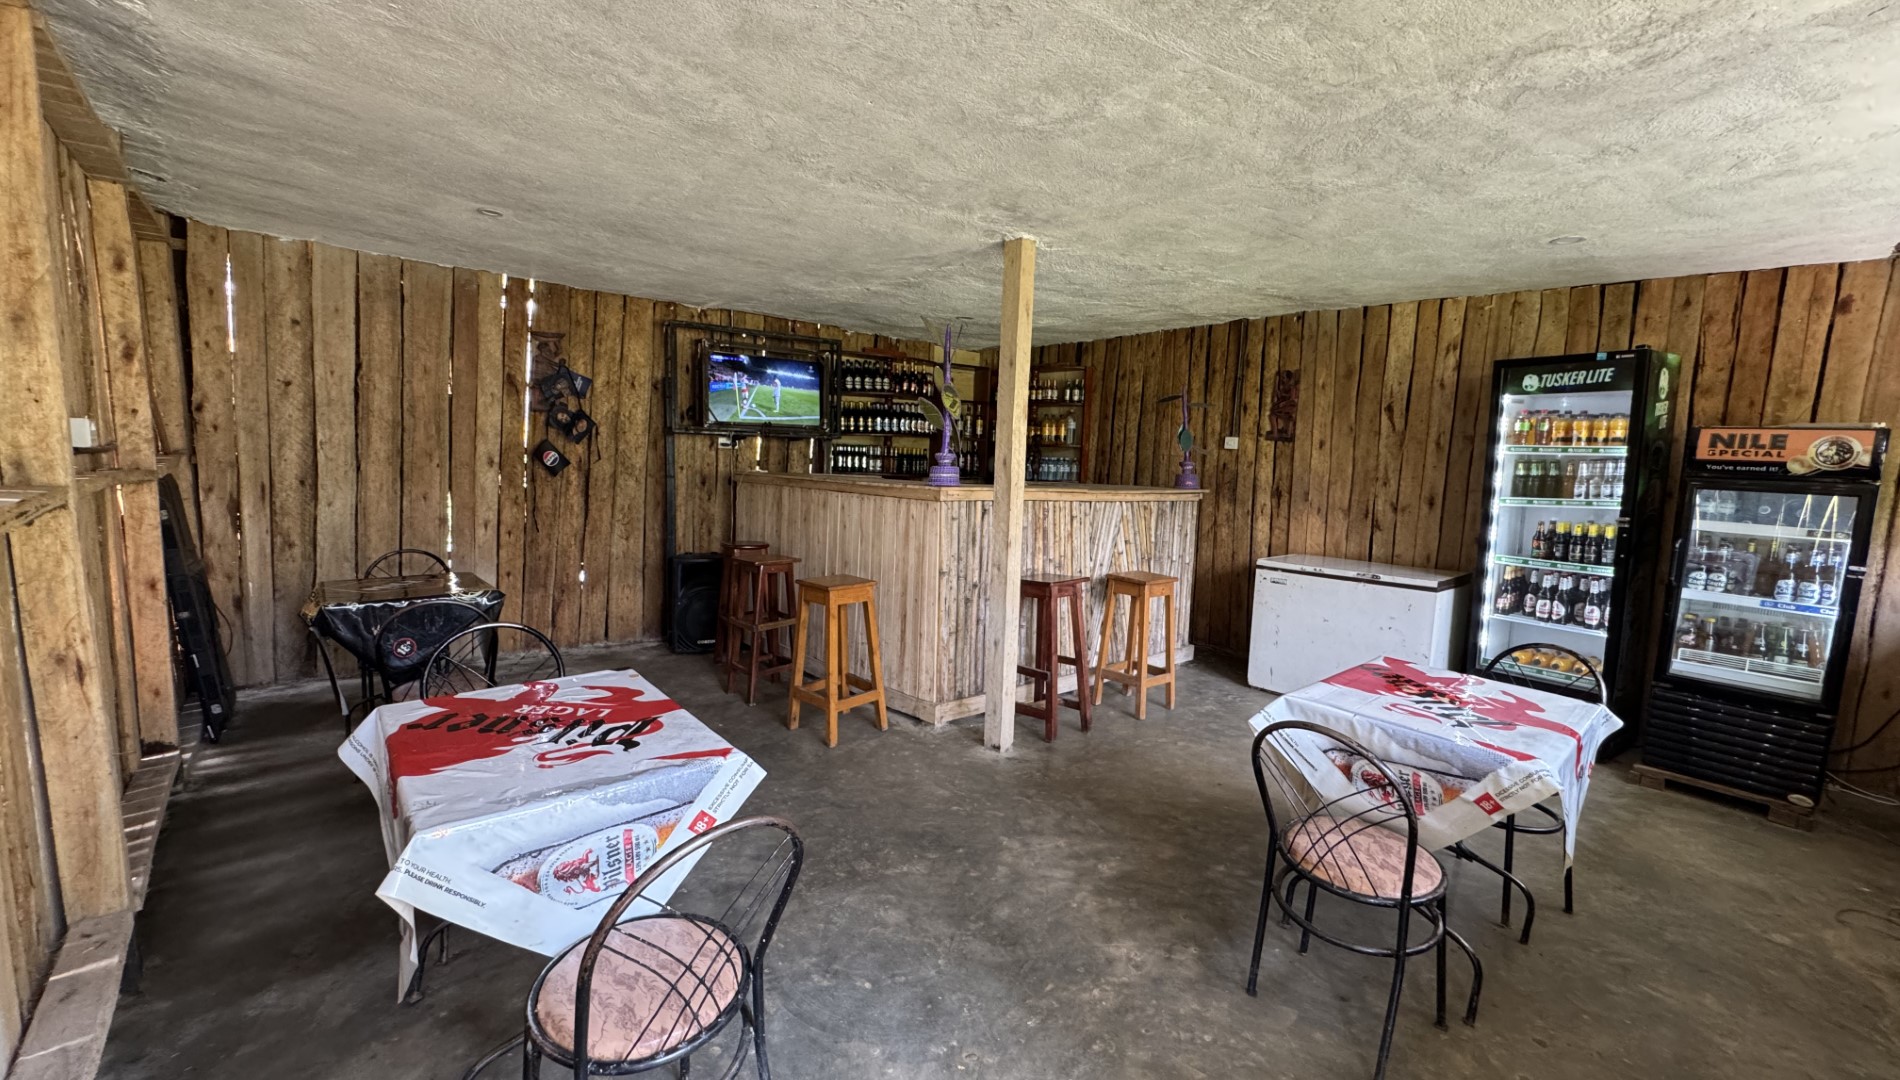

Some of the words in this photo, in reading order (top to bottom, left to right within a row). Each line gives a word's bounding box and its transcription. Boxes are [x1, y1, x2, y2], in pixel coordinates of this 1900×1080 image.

[1540, 371, 1587, 388] TUSKER
[1586, 368, 1616, 384] LITE
[1708, 433, 1789, 450] NILE
[1707, 449, 1785, 458] SPECIAL
[515, 704, 611, 717] LAGER
[708, 783, 730, 811] EXCESSIVE
[713, 791, 732, 813] STRICTLY
[730, 779, 740, 791] NOT
[739, 767, 749, 779] FOR
[694, 815, 709, 833] 18+
[400, 857, 411, 866] TO
[410, 862, 427, 873] YOUR
[602, 835, 624, 891] Pilsner
[624, 842, 633, 870] LAGER
[403, 870, 425, 883] PLEASE
[424, 879, 444, 891] DRINK
[443, 887, 487, 909] RESPONSIBLY.
